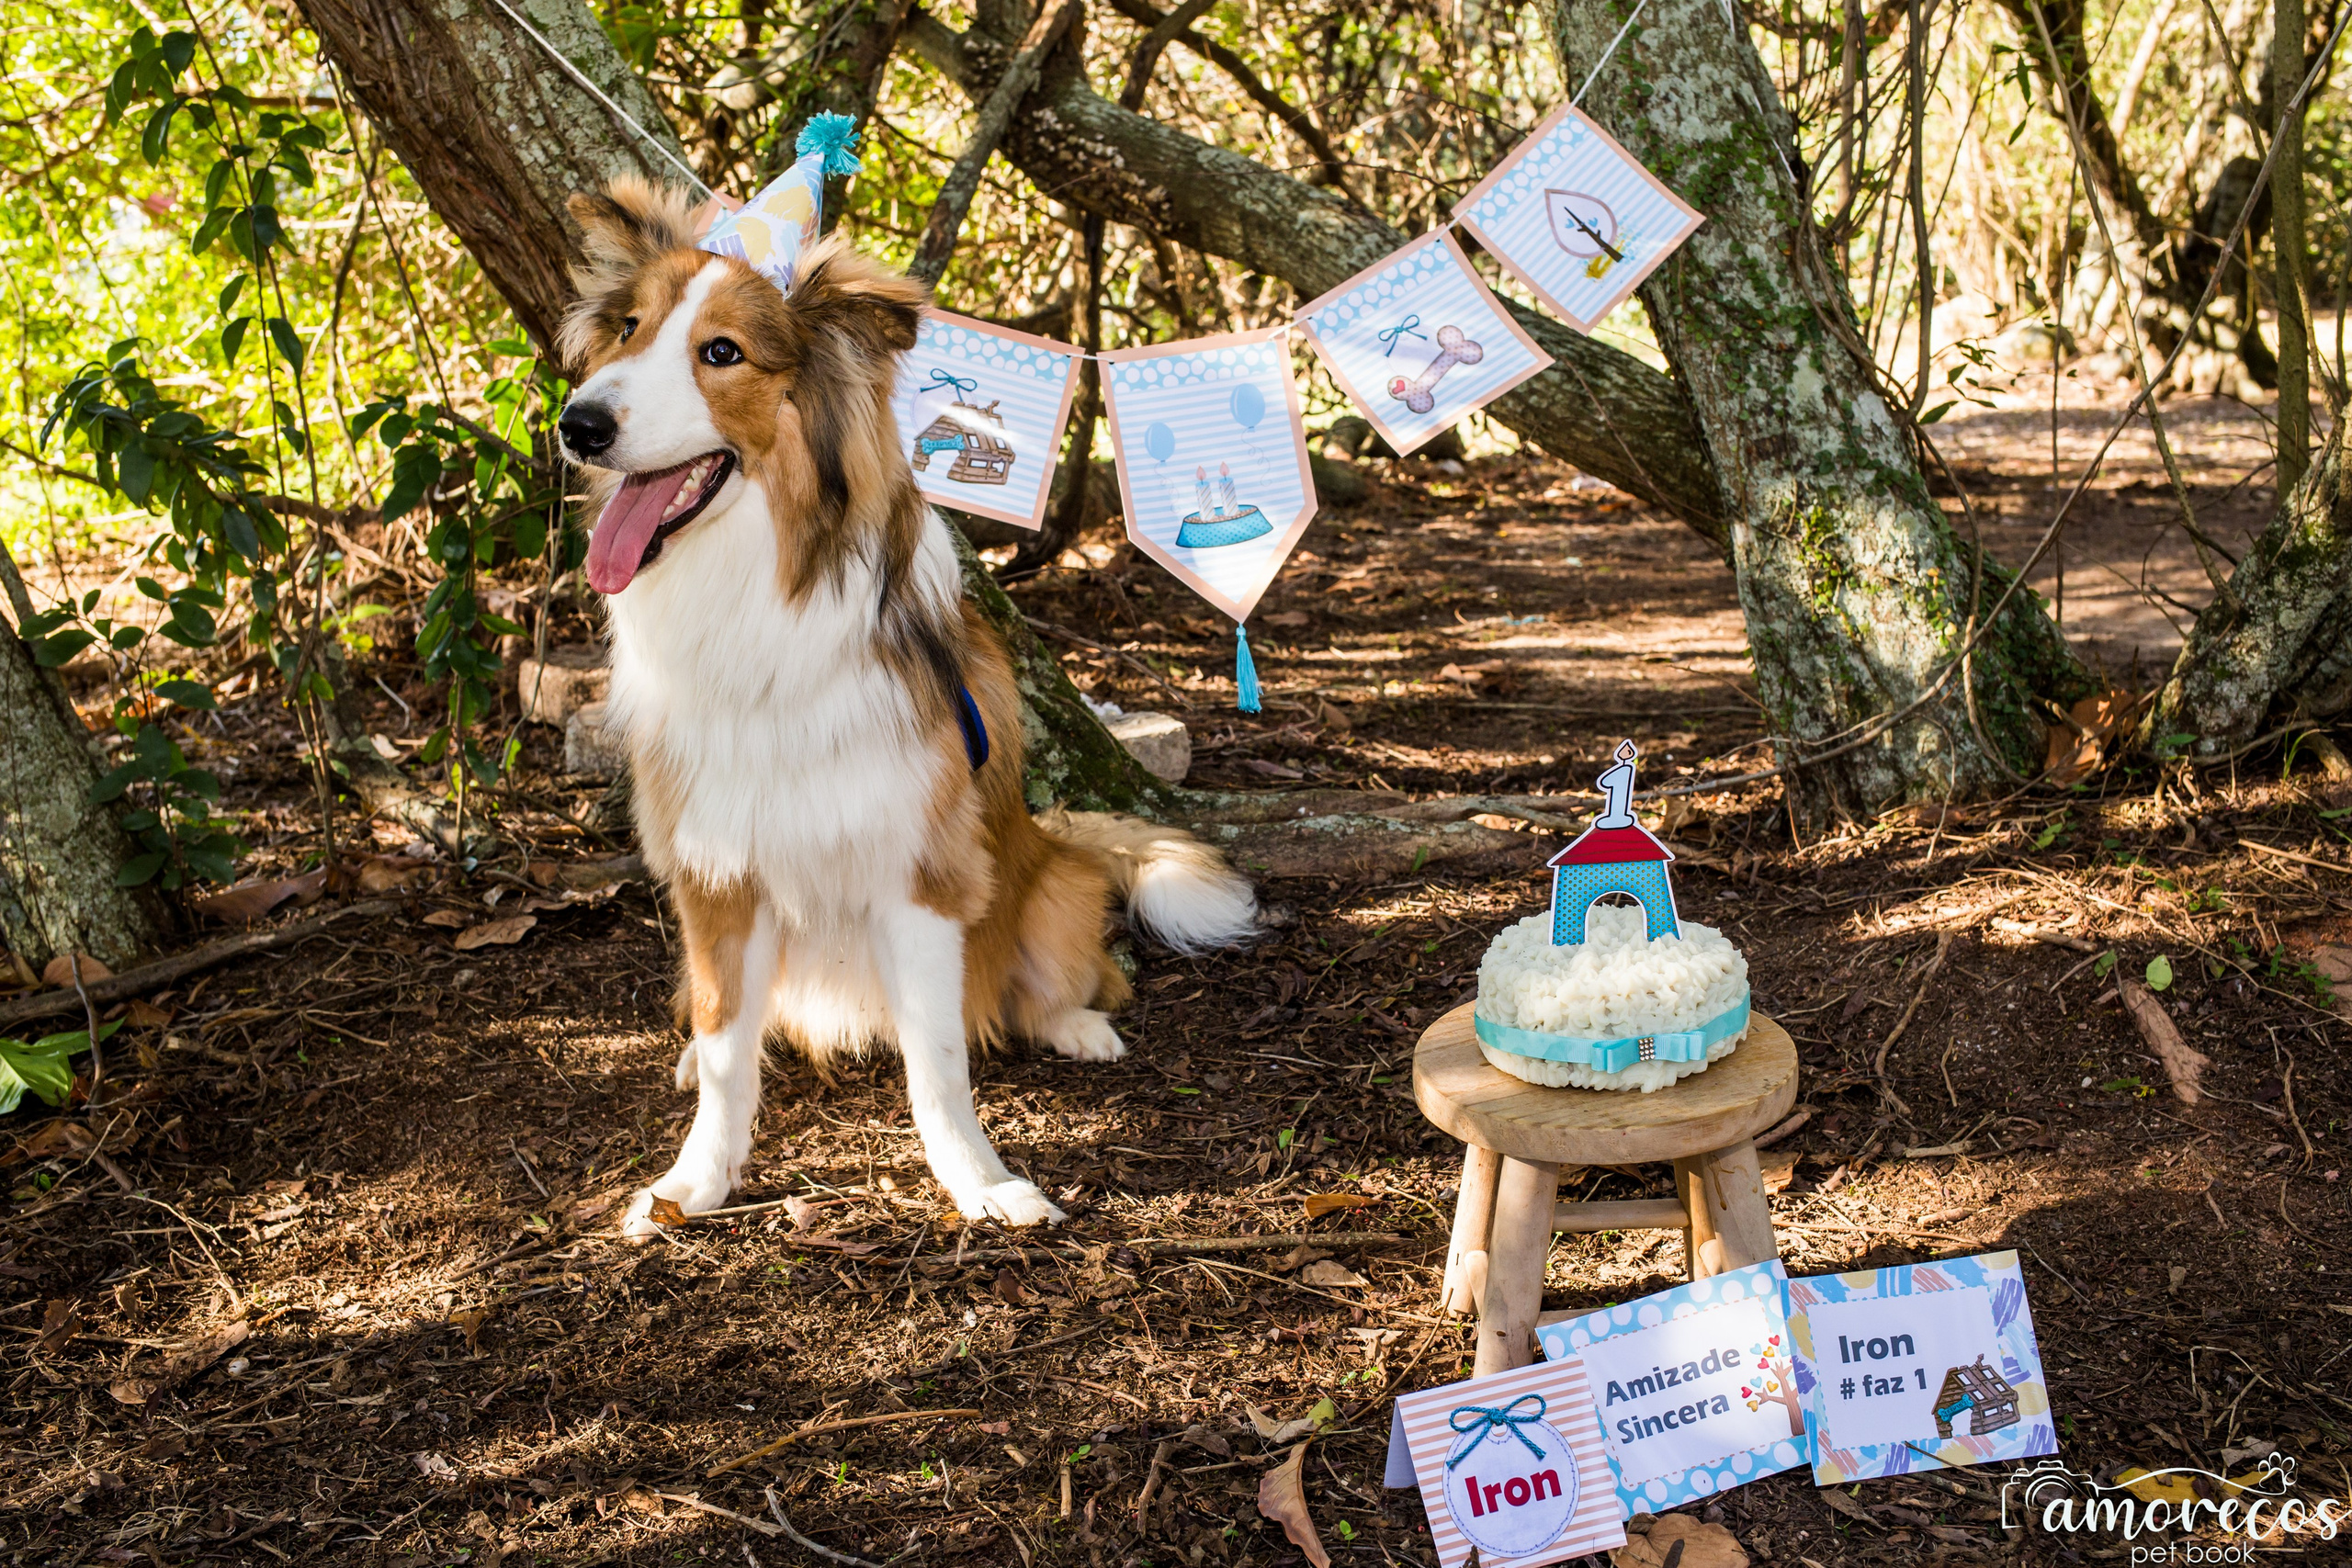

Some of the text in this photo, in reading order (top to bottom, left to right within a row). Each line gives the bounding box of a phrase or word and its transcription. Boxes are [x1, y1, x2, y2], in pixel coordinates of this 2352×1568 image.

[1595, 764, 1635, 829] 1
[1838, 1334, 1915, 1364] Iron
[1606, 1348, 1741, 1407] Amizade
[1862, 1374, 1905, 1397] faz
[1914, 1368, 1927, 1390] 1
[1616, 1394, 1730, 1445] Sincera
[1464, 1469, 1563, 1518] Iron
